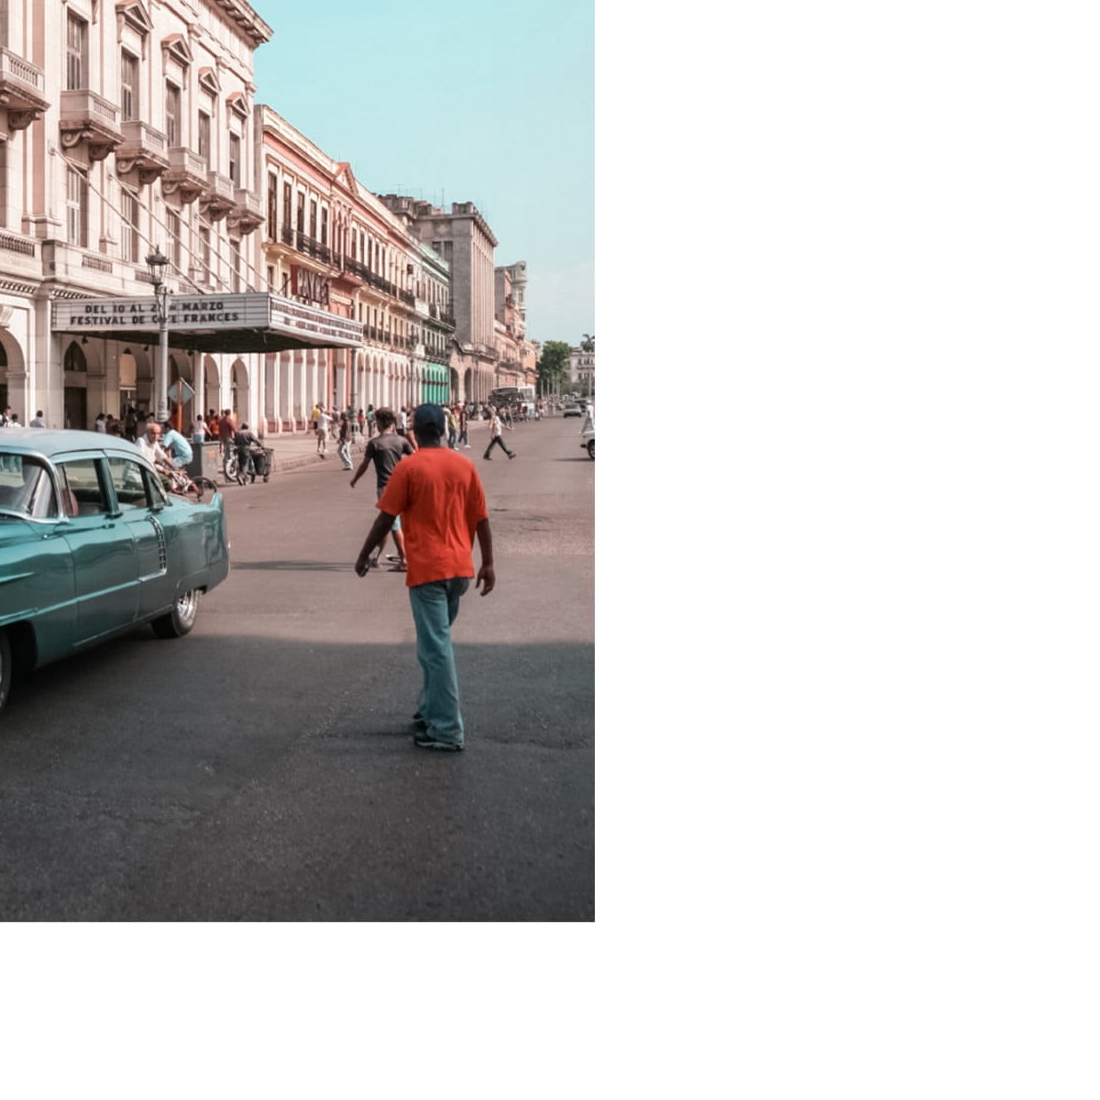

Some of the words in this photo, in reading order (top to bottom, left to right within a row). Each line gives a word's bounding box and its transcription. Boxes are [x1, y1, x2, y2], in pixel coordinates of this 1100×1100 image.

[85, 305, 107, 314] DEL
[130, 303, 145, 313] AL
[182, 301, 224, 311] MARZO
[70, 316, 126, 325] FESTIVAL
[132, 315, 145, 324] DE
[183, 312, 239, 323] FRANCES
